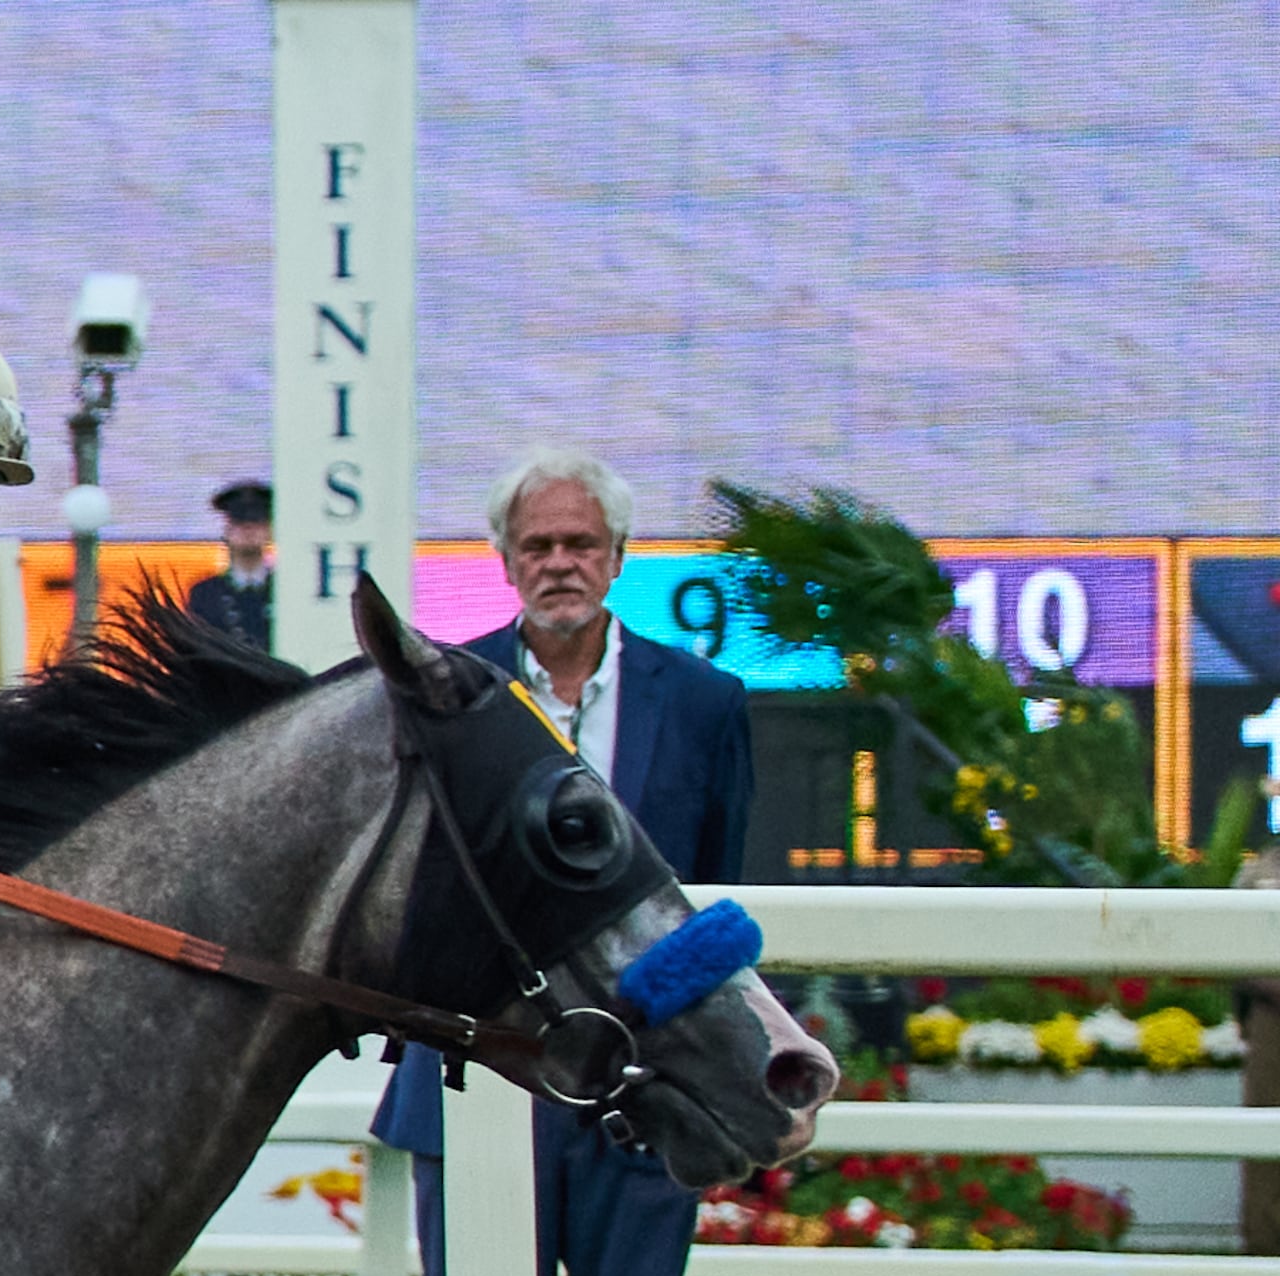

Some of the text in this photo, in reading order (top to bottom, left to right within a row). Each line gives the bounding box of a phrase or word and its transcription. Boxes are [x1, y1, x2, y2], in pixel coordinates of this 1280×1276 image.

[311, 143, 373, 599] FINISH
[673, 577, 725, 659] 9
[953, 571, 1089, 672] 10
